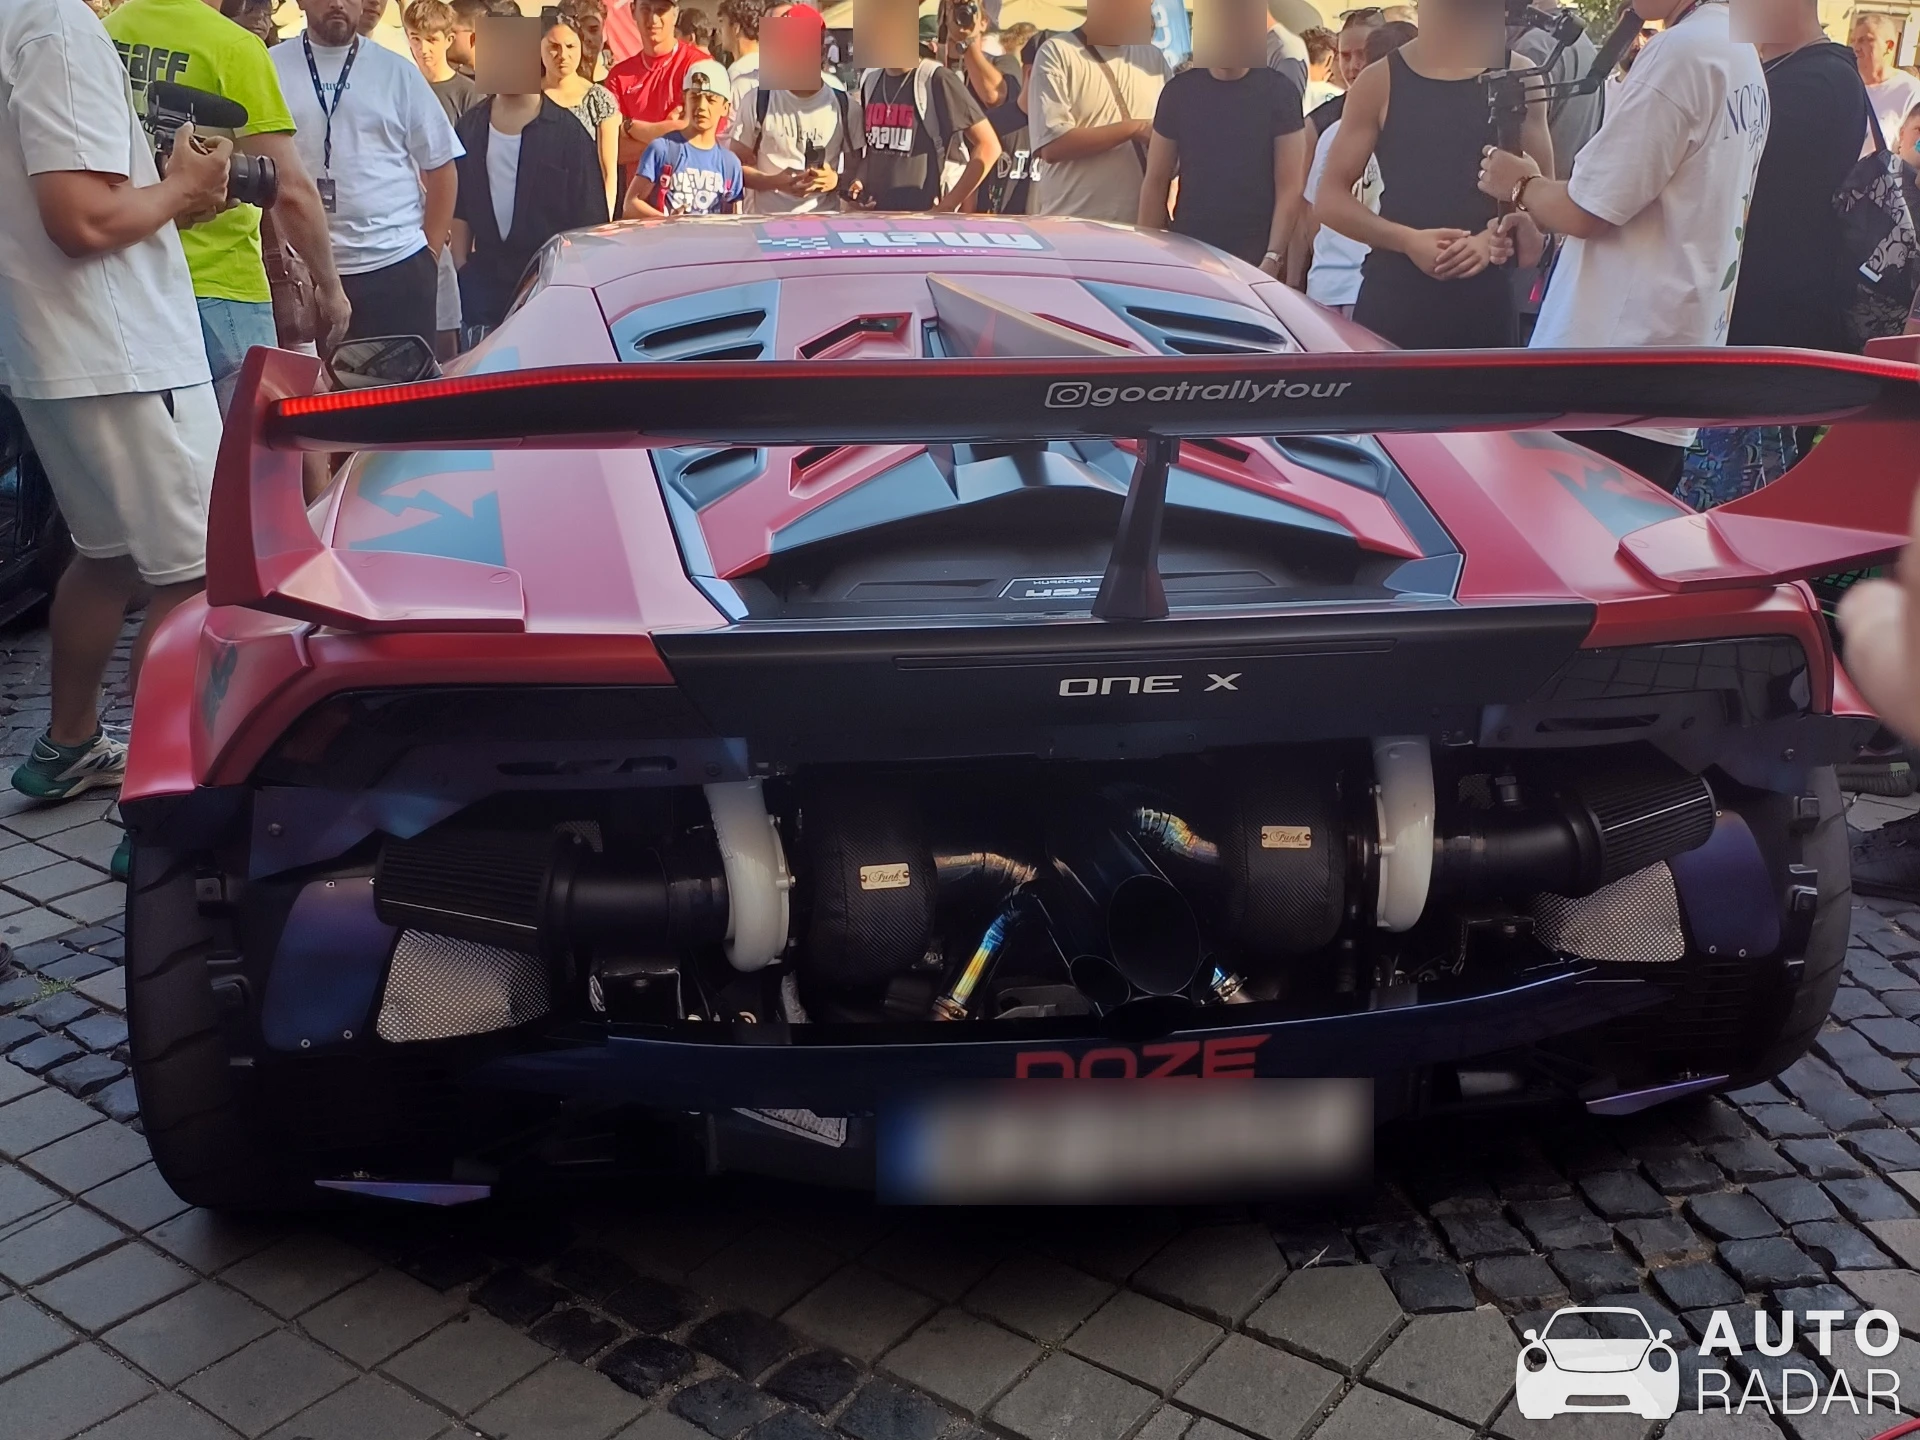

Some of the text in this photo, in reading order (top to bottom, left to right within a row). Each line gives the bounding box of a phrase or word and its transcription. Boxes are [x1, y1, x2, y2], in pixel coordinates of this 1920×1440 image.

[1090, 379, 1352, 407] goatrallytour
[1058, 672, 1243, 697] ONE X
